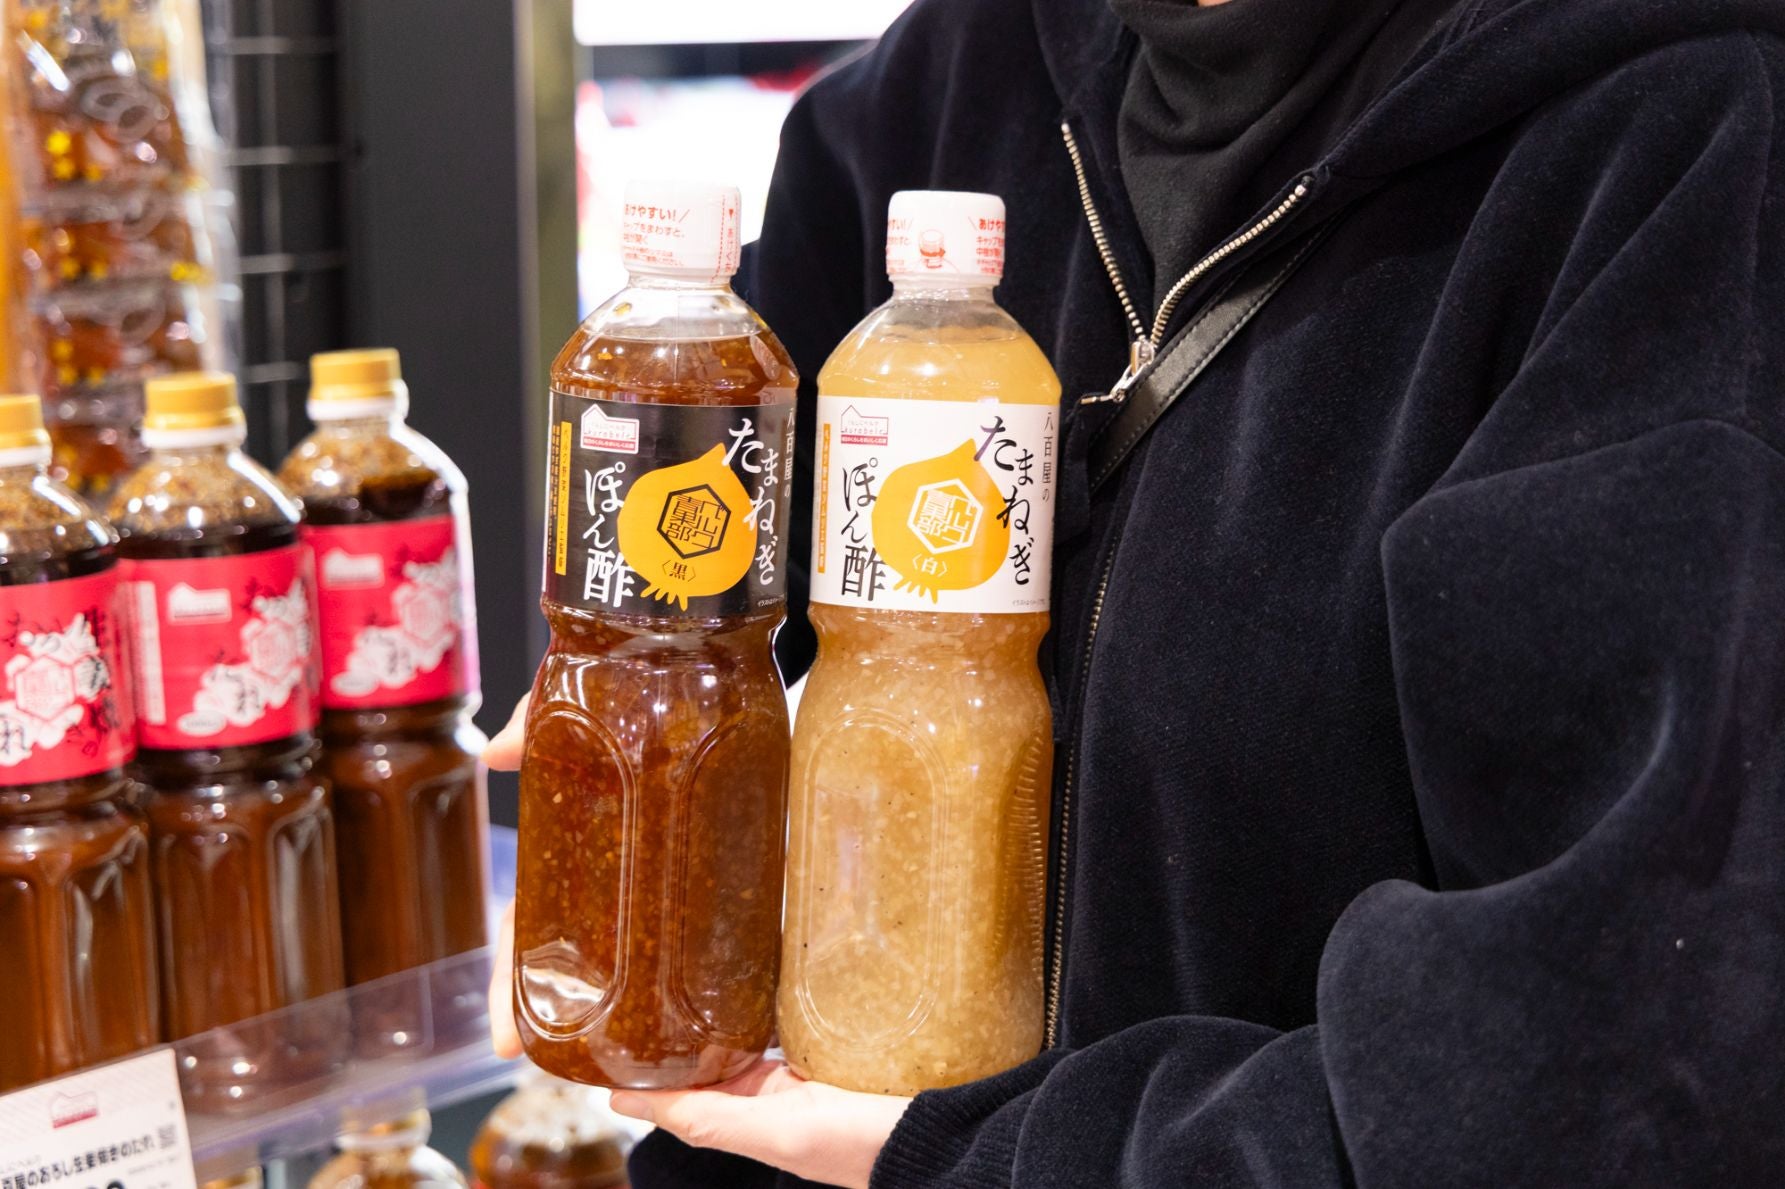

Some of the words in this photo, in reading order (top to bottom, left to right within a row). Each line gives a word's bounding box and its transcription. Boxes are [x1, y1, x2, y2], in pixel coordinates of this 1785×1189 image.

[582, 461, 637, 608] ぽん酢
[721, 418, 779, 586] たまねぎ
[841, 457, 888, 601] ぽん酢
[973, 416, 1035, 585] たまねぎ
